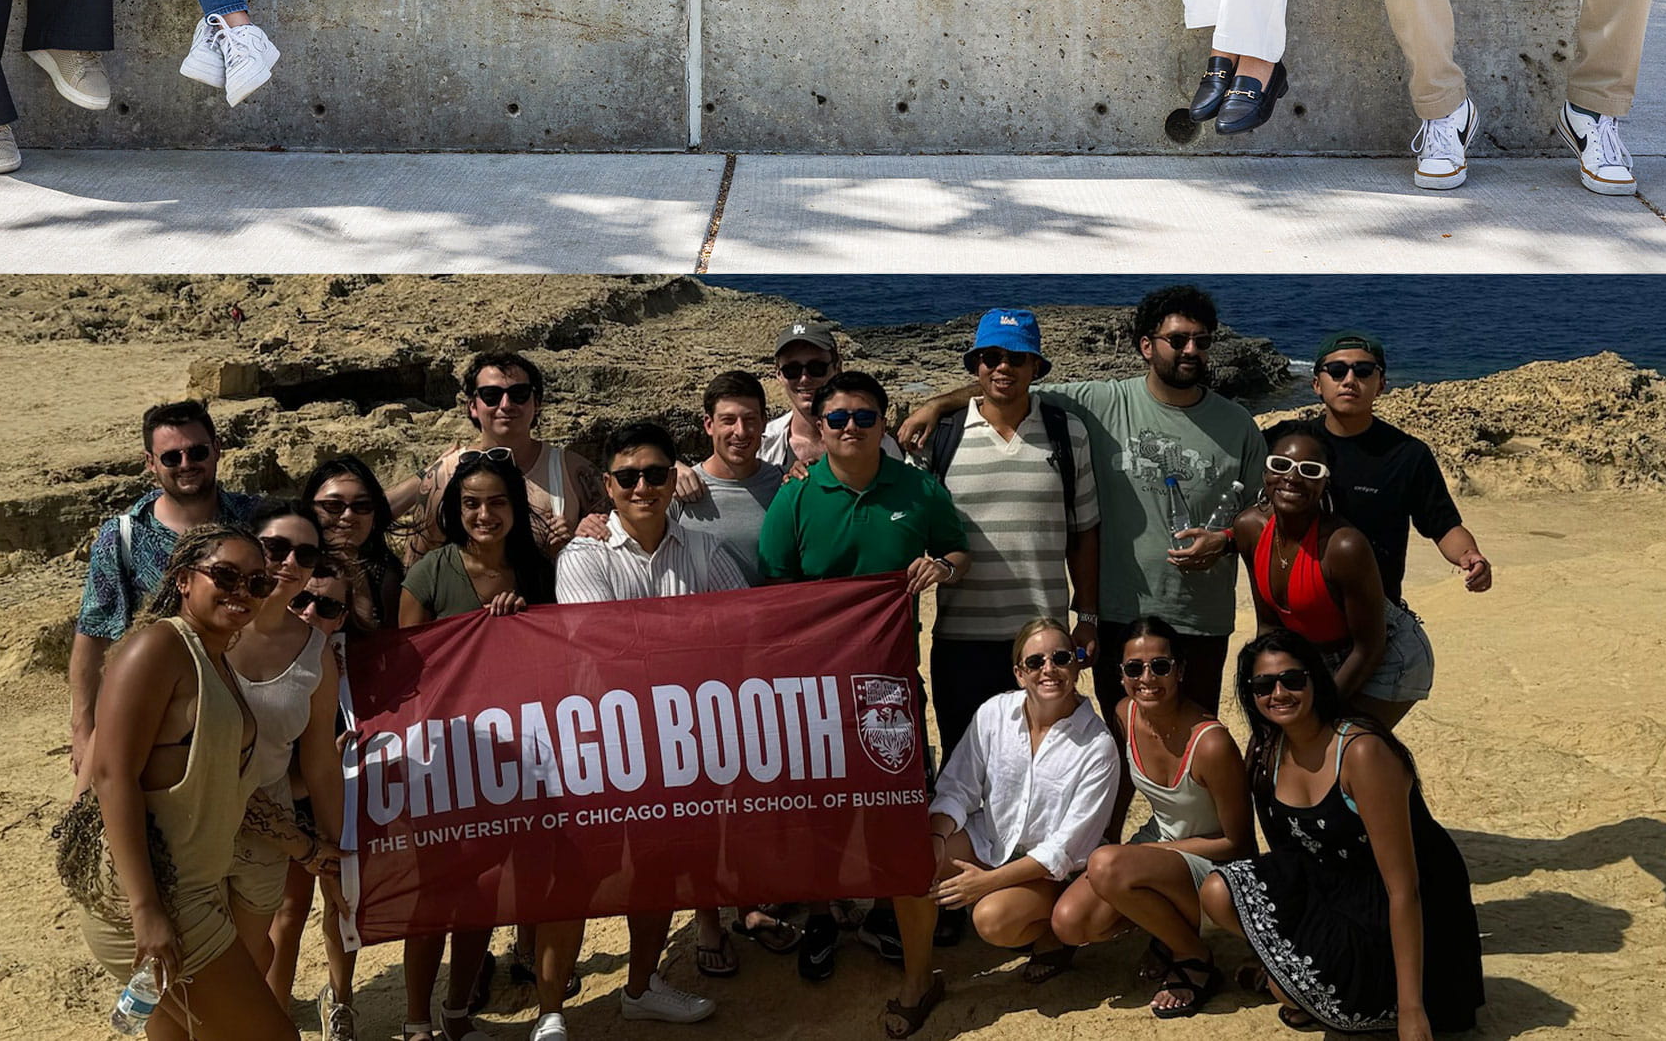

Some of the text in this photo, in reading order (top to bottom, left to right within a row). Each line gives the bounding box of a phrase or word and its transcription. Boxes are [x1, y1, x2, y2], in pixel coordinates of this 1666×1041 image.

[365, 675, 847, 826] CHICAGO BOOTH
[367, 788, 926, 855] THE UNIVERSITY OF CHICAGO BOOTH SCHOOL OF BUSINESS
